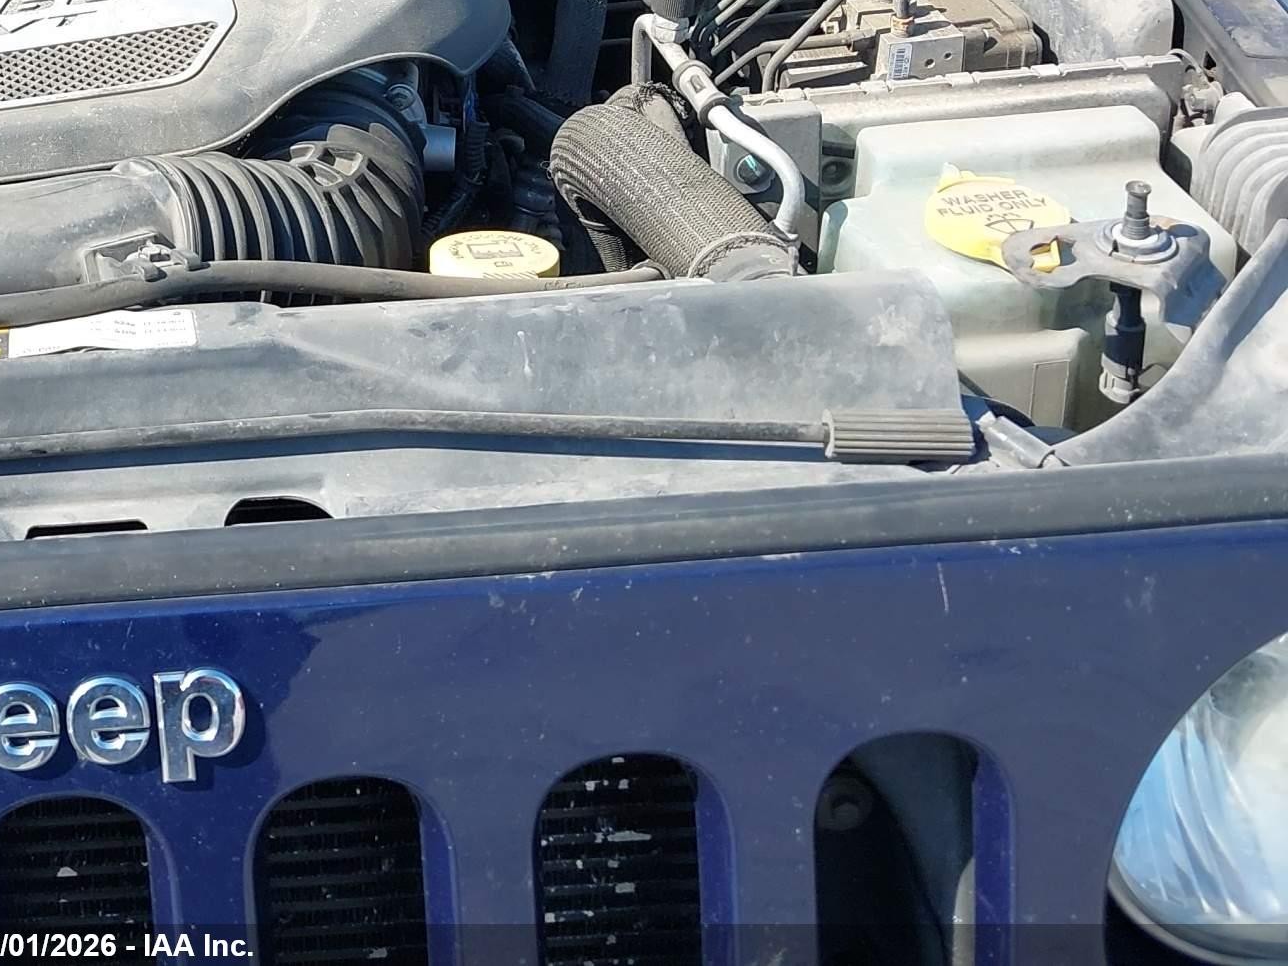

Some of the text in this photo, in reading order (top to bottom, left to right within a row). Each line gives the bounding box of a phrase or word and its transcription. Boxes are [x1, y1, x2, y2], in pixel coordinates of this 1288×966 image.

[936, 196, 1048, 218] FLUID ONLY
[942, 189, 1028, 207] WASHER
